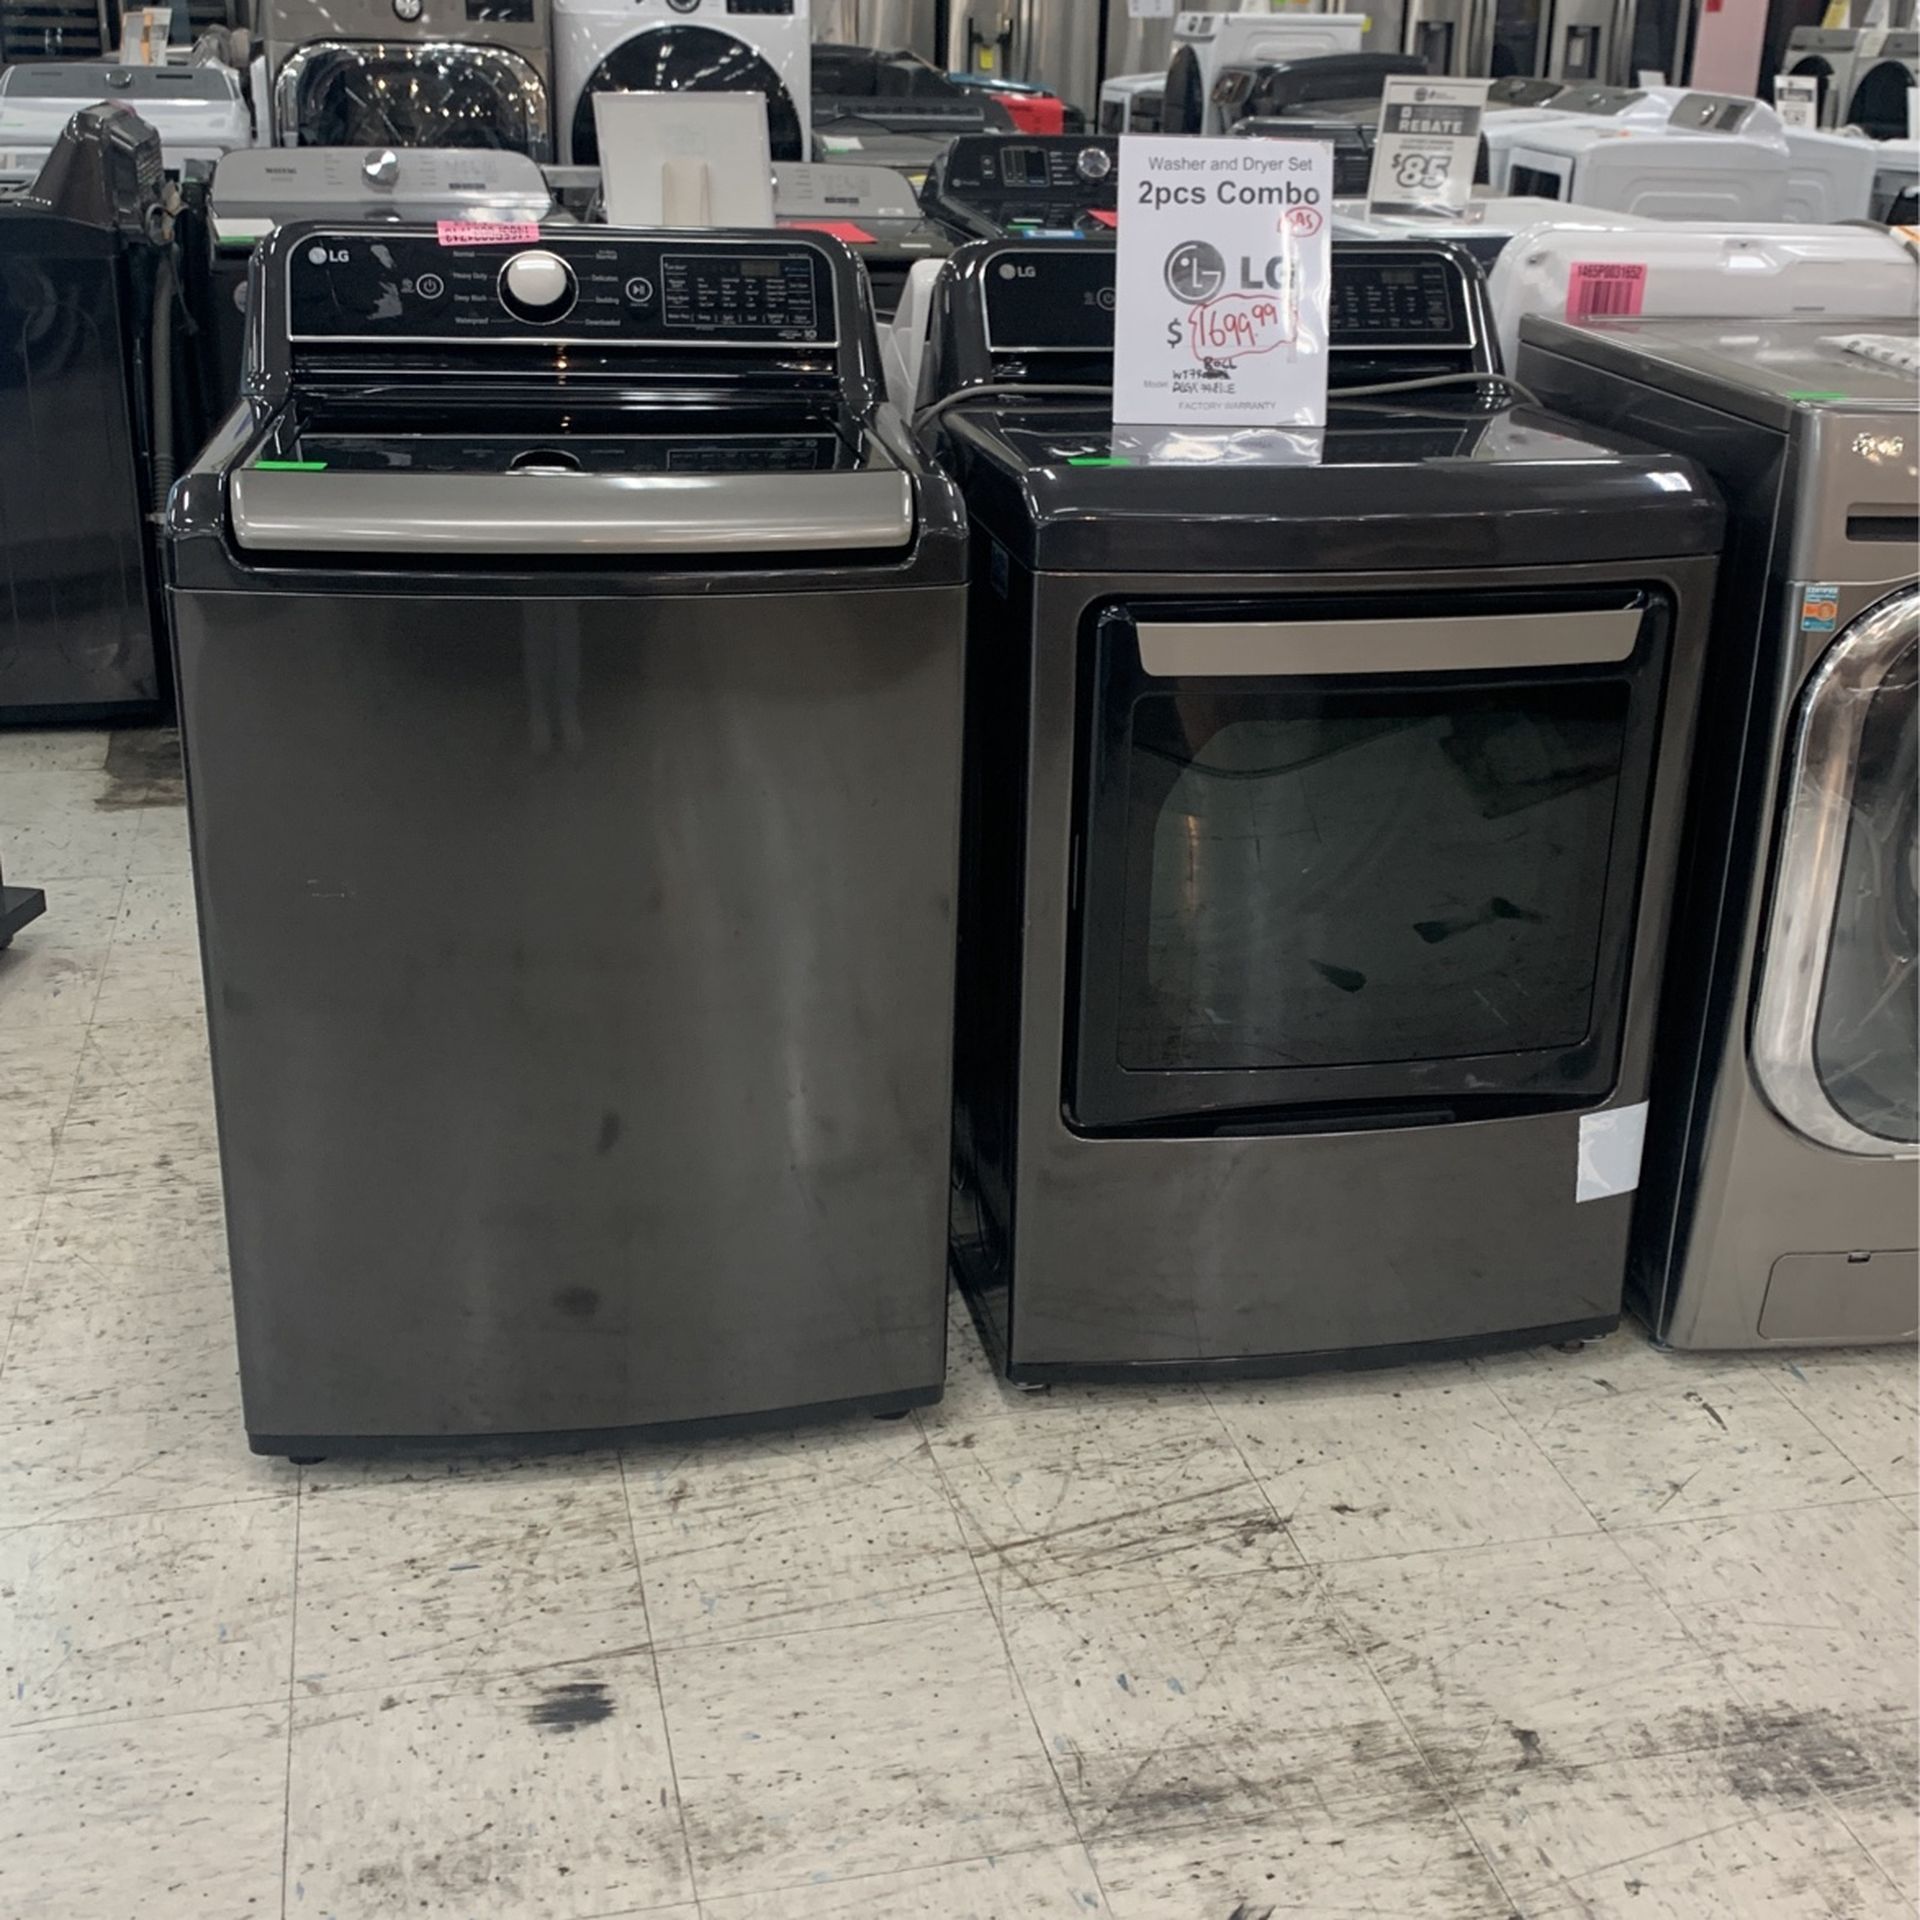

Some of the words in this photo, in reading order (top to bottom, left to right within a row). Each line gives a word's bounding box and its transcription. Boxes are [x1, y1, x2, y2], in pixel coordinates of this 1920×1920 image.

[1398, 120, 1463, 134] REBATE
[1148, 157, 1206, 171] Washer
[1210, 157, 1238, 171] and
[1243, 157, 1283, 174] Dryer
[1288, 157, 1313, 171] Set
[1391, 153, 1452, 189] $85
[1138, 181, 1206, 210] 2pcs
[1217, 181, 1320, 205] Combo
[329, 250, 350, 263] LG
[1017, 266, 1036, 278] LG
[1240, 256, 1296, 290] LG
[1179, 401, 1221, 410] FACTORY
[1223, 401, 1276, 410] WARRANTY
